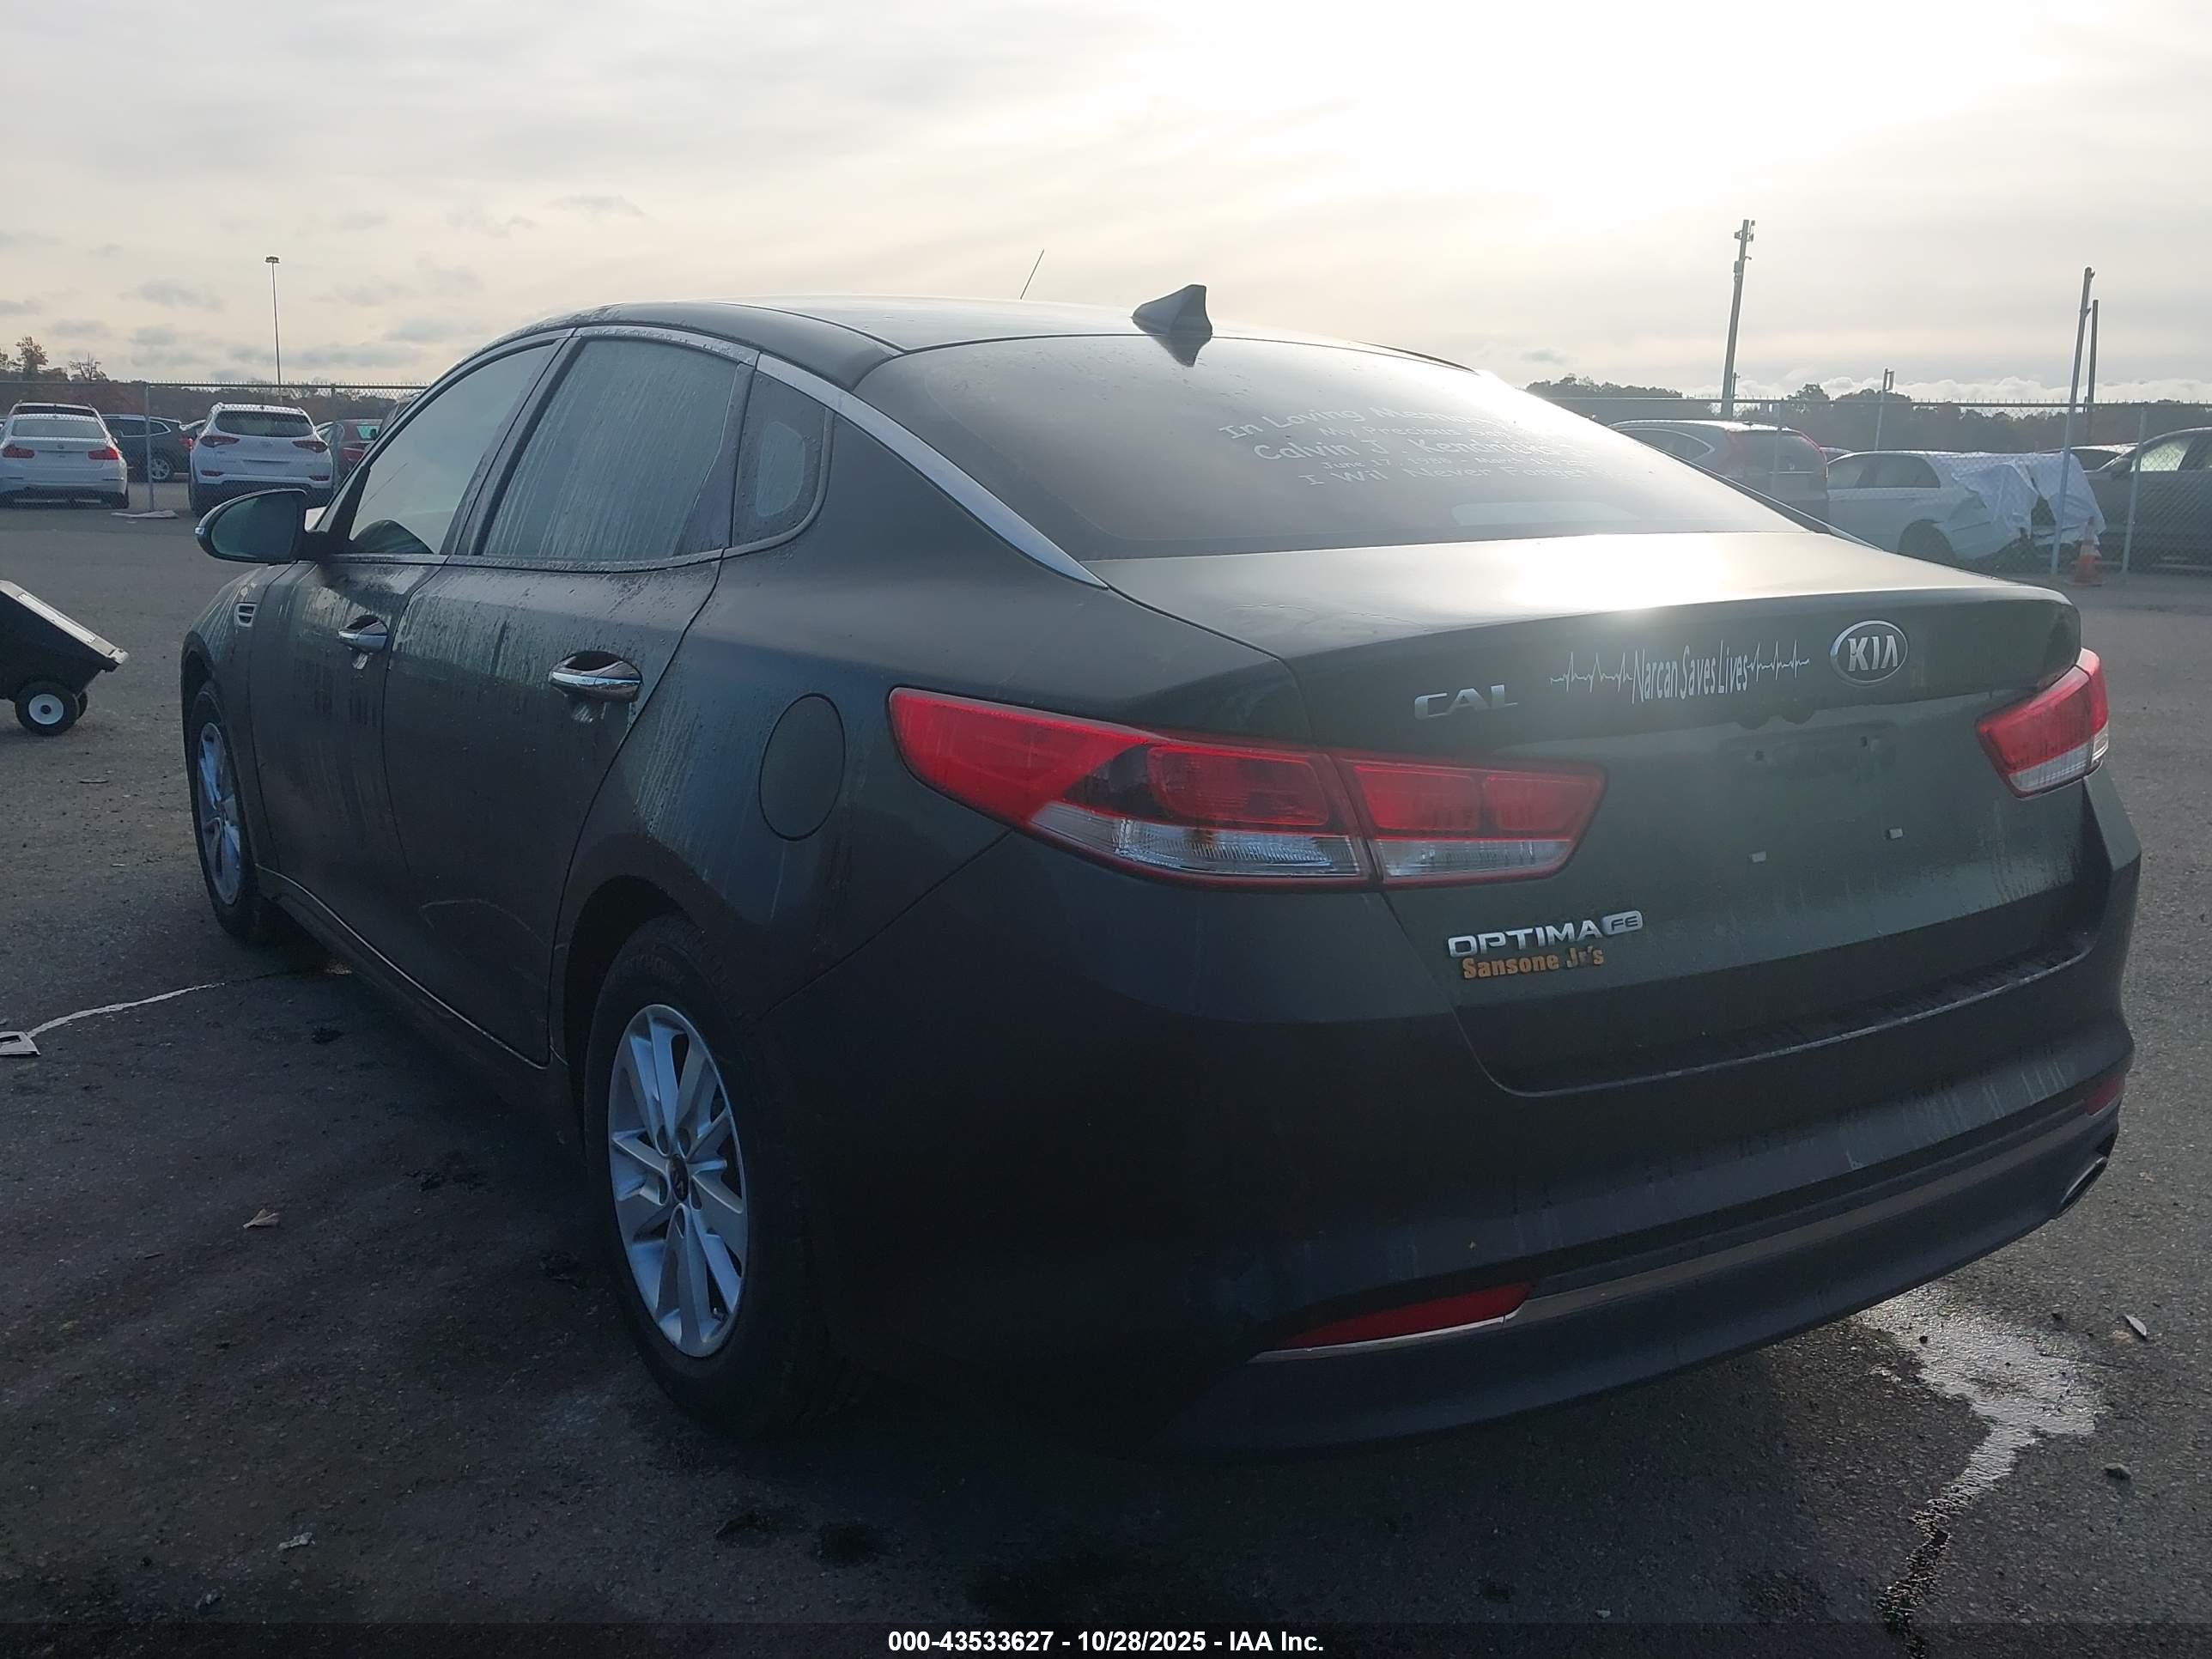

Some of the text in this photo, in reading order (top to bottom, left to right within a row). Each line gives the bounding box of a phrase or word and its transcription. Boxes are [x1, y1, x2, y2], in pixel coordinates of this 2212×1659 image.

[1218, 424, 1264, 439] In
[1261, 410, 1365, 428] Loving
[1360, 424, 1463, 435] Precious
[1254, 441, 1360, 459] Calvin
[1297, 475, 1325, 486] I
[1401, 467, 1491, 478] Never
[1848, 635, 1898, 672] KIA
[1632, 639, 1748, 704] Narcan Saves Lives
[1415, 684, 1518, 720] CAL
[1448, 915, 1638, 957] OPTIMA FE
[1462, 946, 1604, 979] Sansone Jr's
